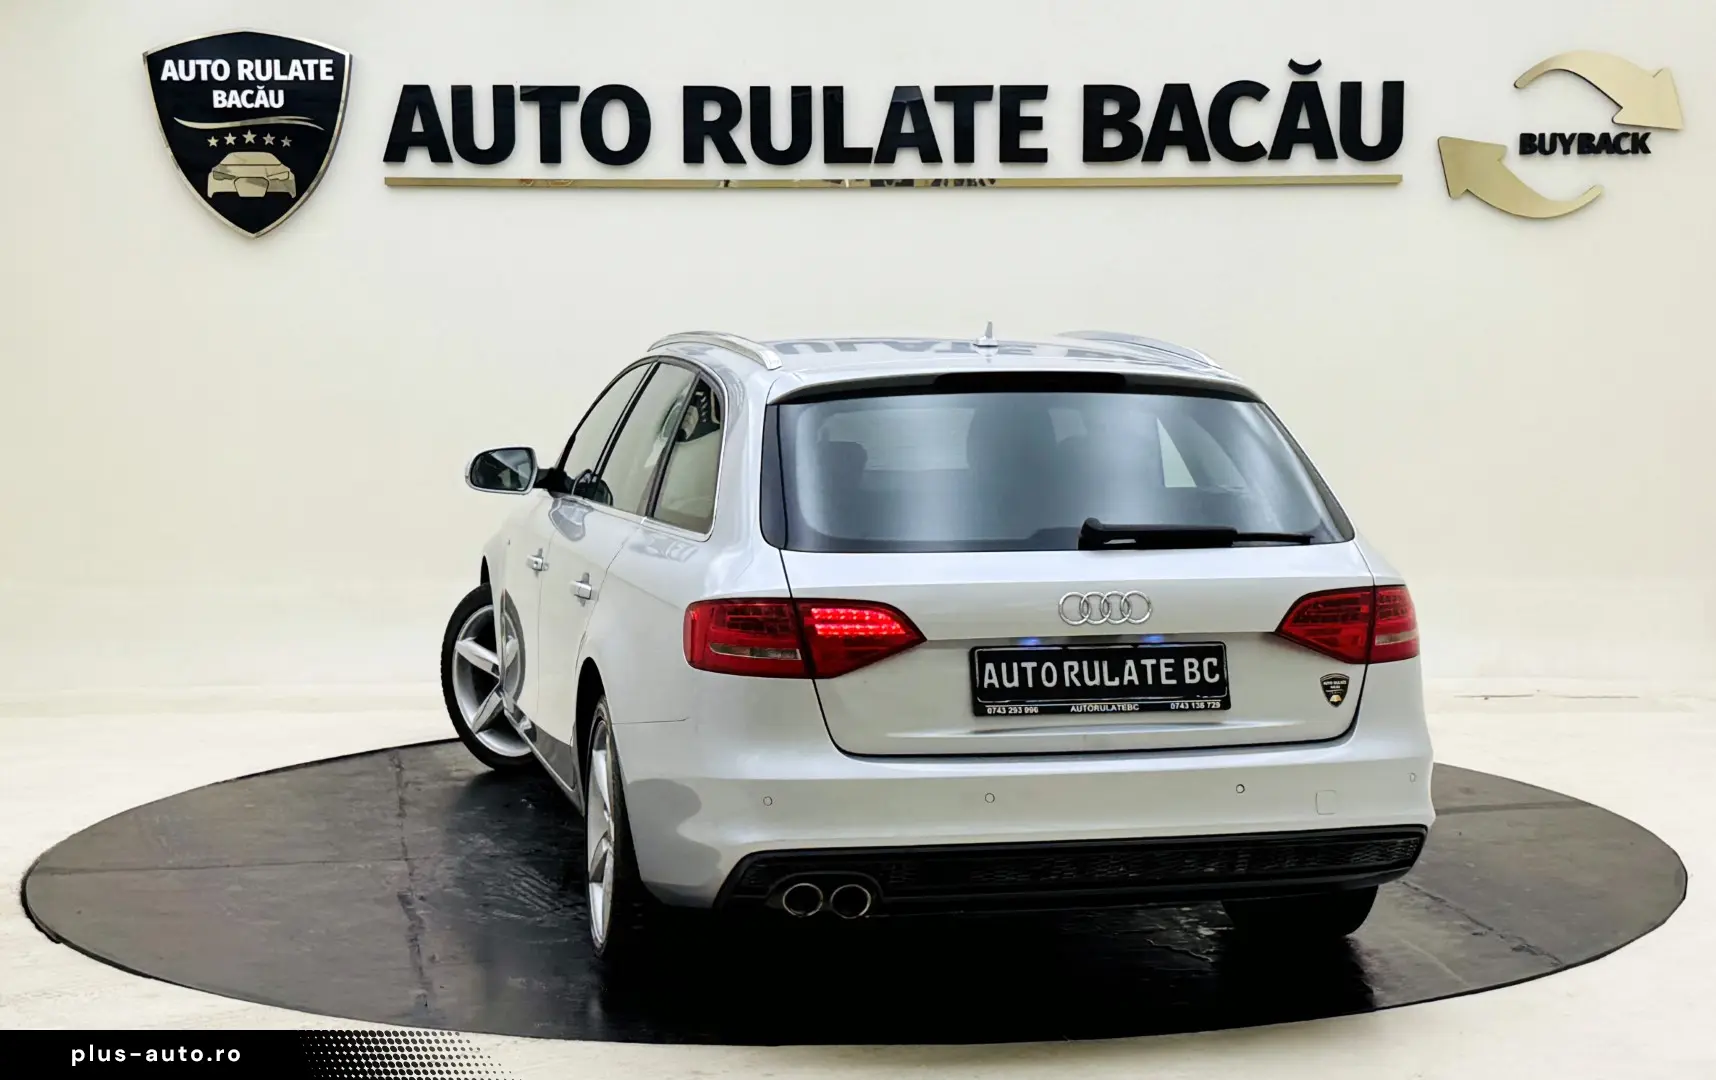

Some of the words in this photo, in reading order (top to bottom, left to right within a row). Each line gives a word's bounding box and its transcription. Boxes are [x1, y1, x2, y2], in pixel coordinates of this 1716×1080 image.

[161, 59, 230, 82] AUTO
[237, 58, 335, 82] RULATE
[212, 85, 285, 109] BACĂU
[383, 84, 652, 167] AUTO
[682, 82, 1049, 167] RULATE
[1082, 58, 1405, 164] BACĂU
[1518, 132, 1652, 156] BUYBACK
[983, 661, 1058, 689] AUTO
[1063, 658, 1177, 688] RULATE
[1183, 657, 1220, 684] BC
[1070, 703, 1140, 713] AUTORULATEBC
[1170, 701, 1190, 710] 0743
